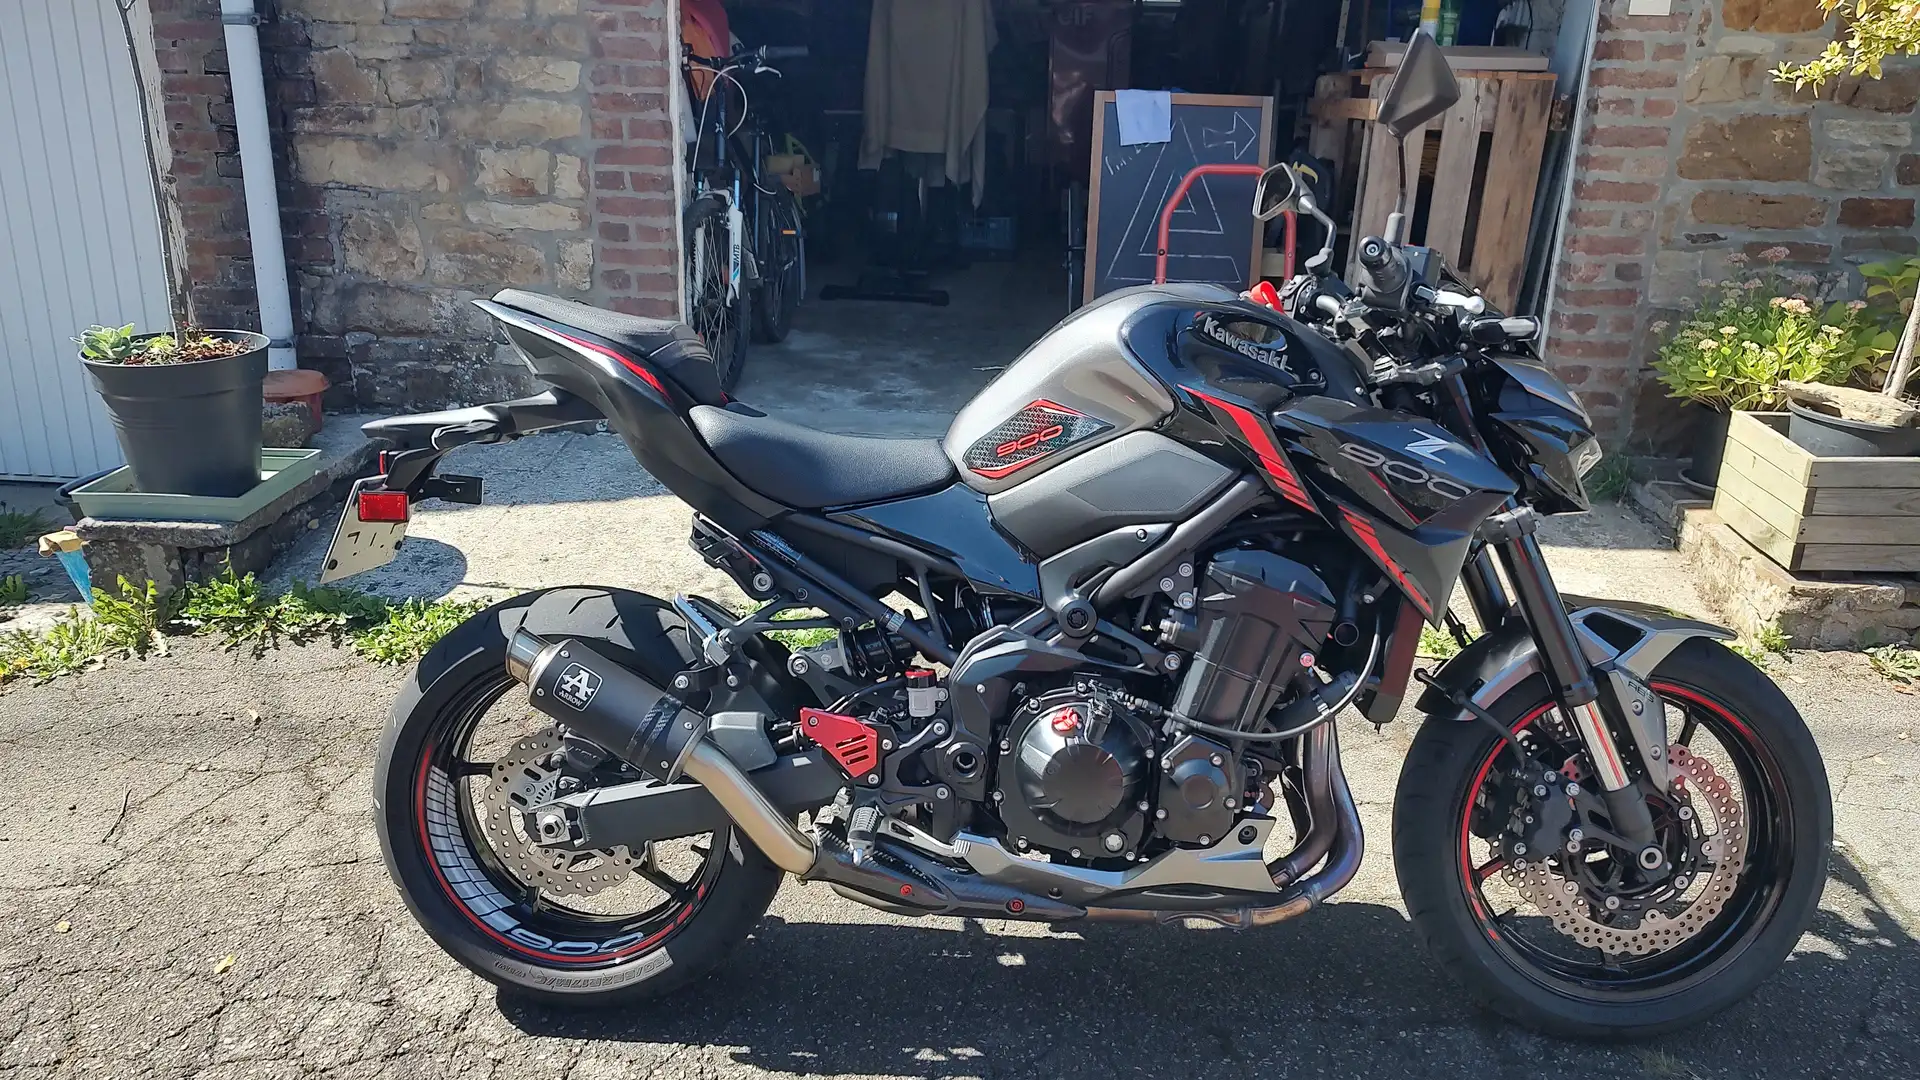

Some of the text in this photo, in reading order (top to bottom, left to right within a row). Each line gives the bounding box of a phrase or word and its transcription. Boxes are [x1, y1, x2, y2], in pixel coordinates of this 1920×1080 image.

[1203, 316, 1291, 371] Kawasaki
[996, 425, 1064, 458] 900
[1337, 442, 1472, 500] 900
[558, 690, 583, 707] ARROW
[1627, 681, 1655, 703] ABS
